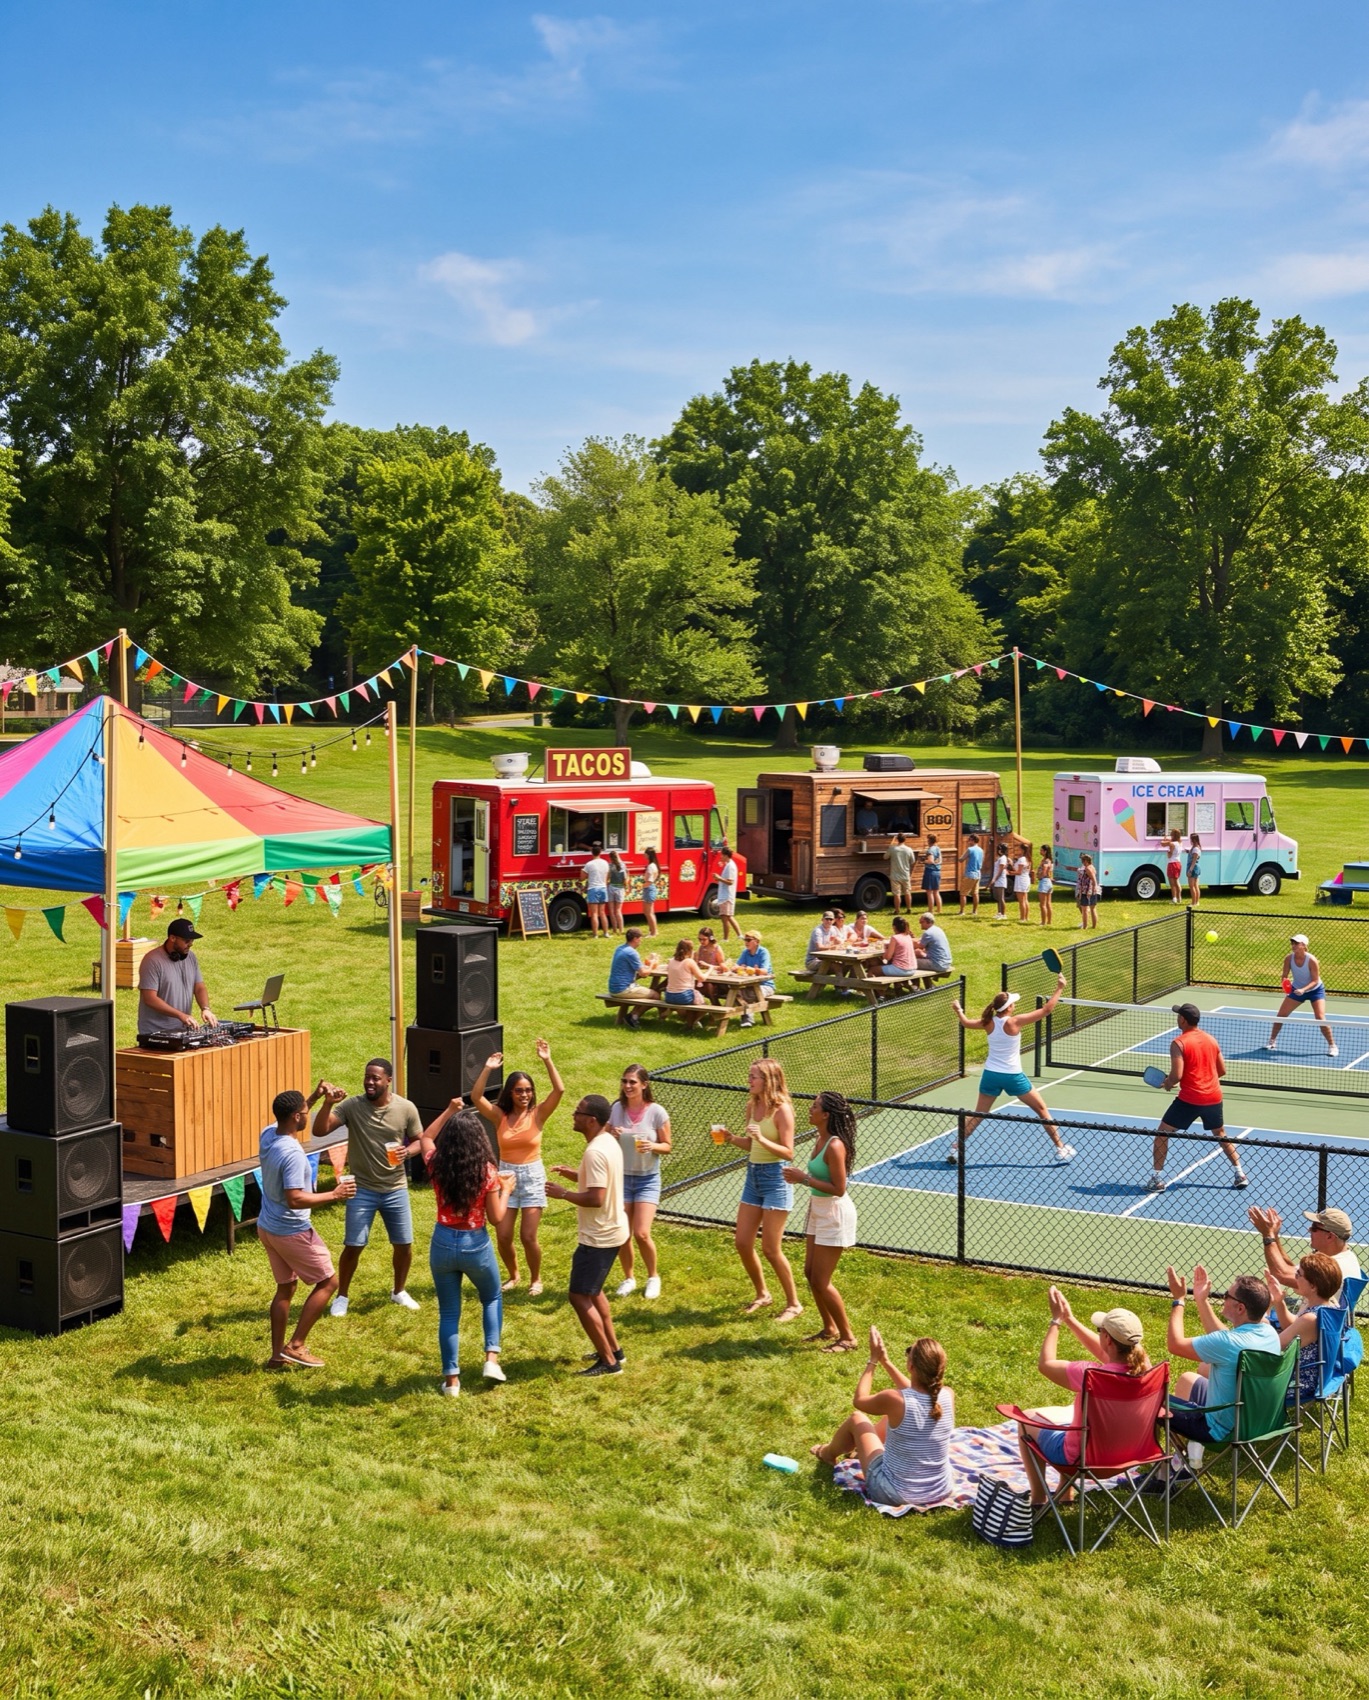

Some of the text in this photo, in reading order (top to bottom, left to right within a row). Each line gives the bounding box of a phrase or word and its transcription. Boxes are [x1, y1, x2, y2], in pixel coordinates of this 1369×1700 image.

[552, 752, 626, 777] TACOS
[1132, 785, 1205, 797] ICE CREAM
[926, 814, 952, 825] BBQ
